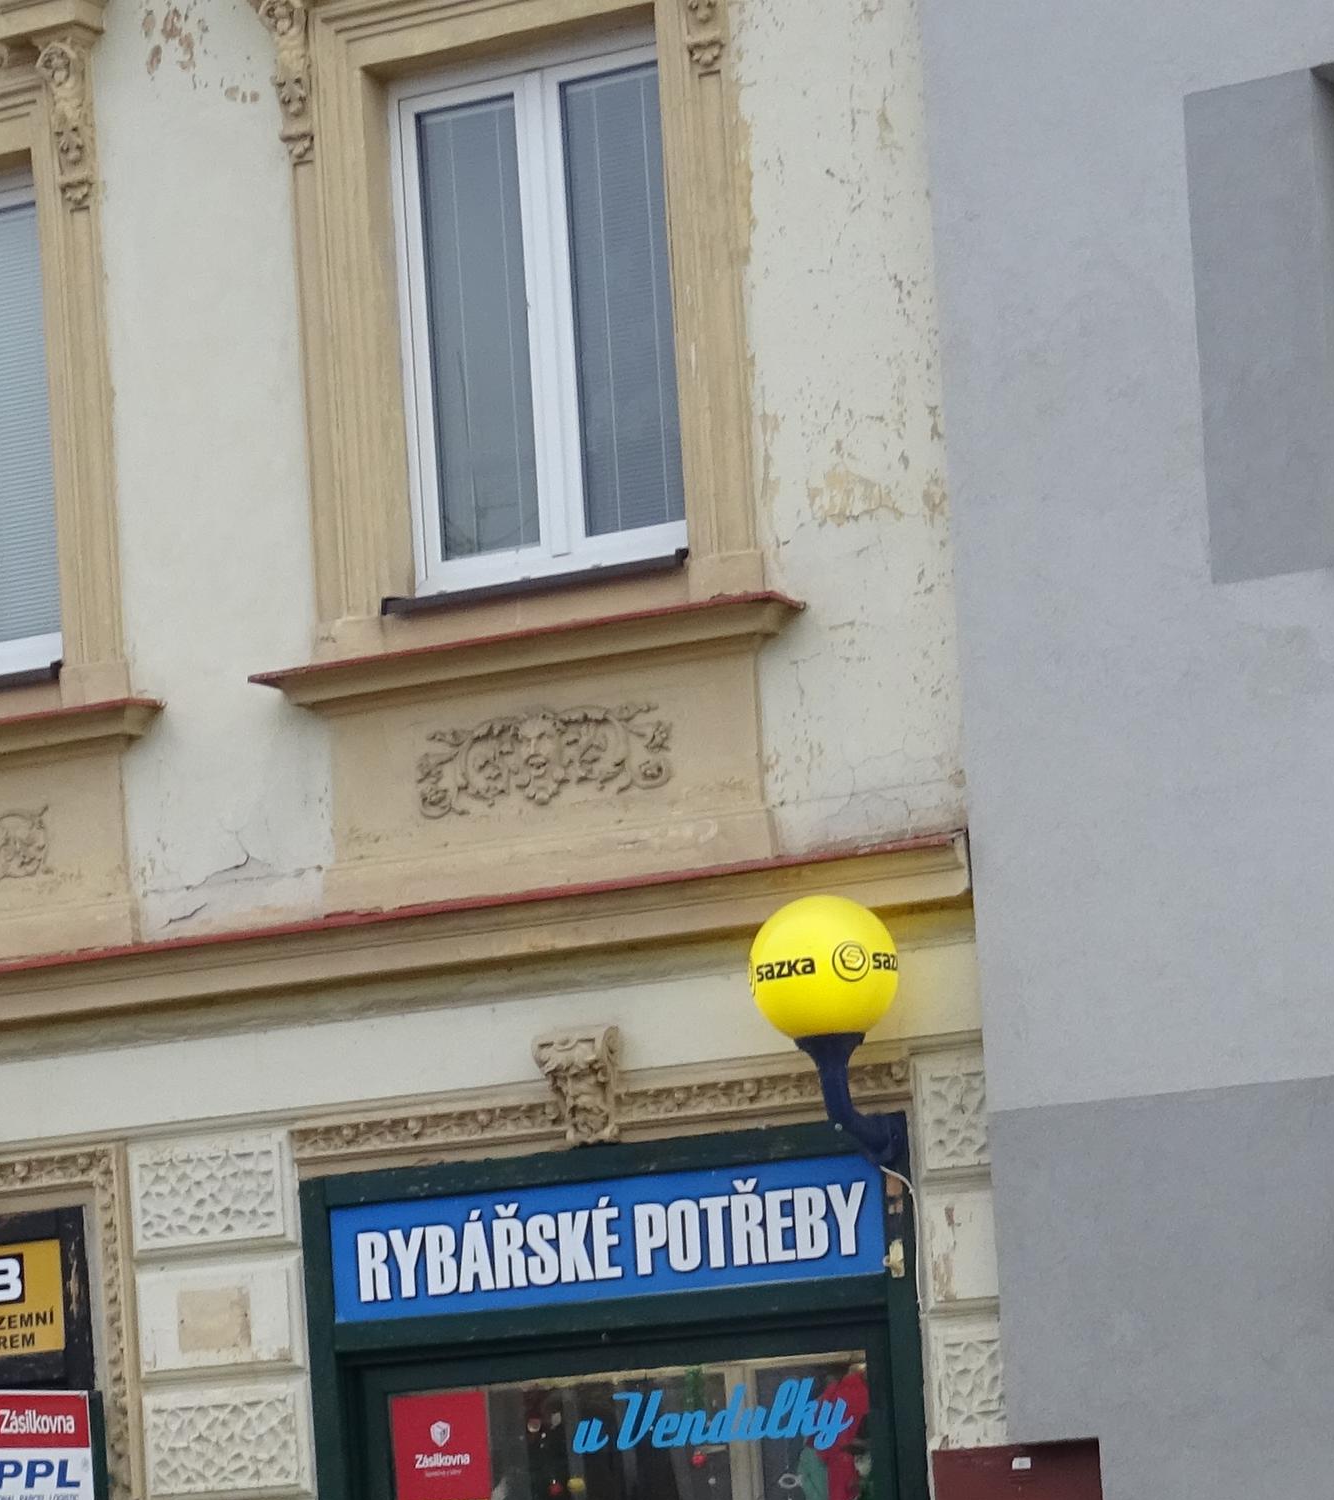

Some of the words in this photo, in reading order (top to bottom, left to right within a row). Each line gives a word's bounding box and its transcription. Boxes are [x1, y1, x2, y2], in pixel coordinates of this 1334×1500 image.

[755, 957, 817, 983] sazka
[871, 951, 899, 972] saz
[356, 1196, 623, 1303] RYBÁŘSKÉ
[633, 1177, 866, 1277] POTŘEBY
[572, 1416, 610, 1454] u
[613, 1376, 854, 1451] Vendulky
[414, 1452, 471, 1469] Zásilkovna
